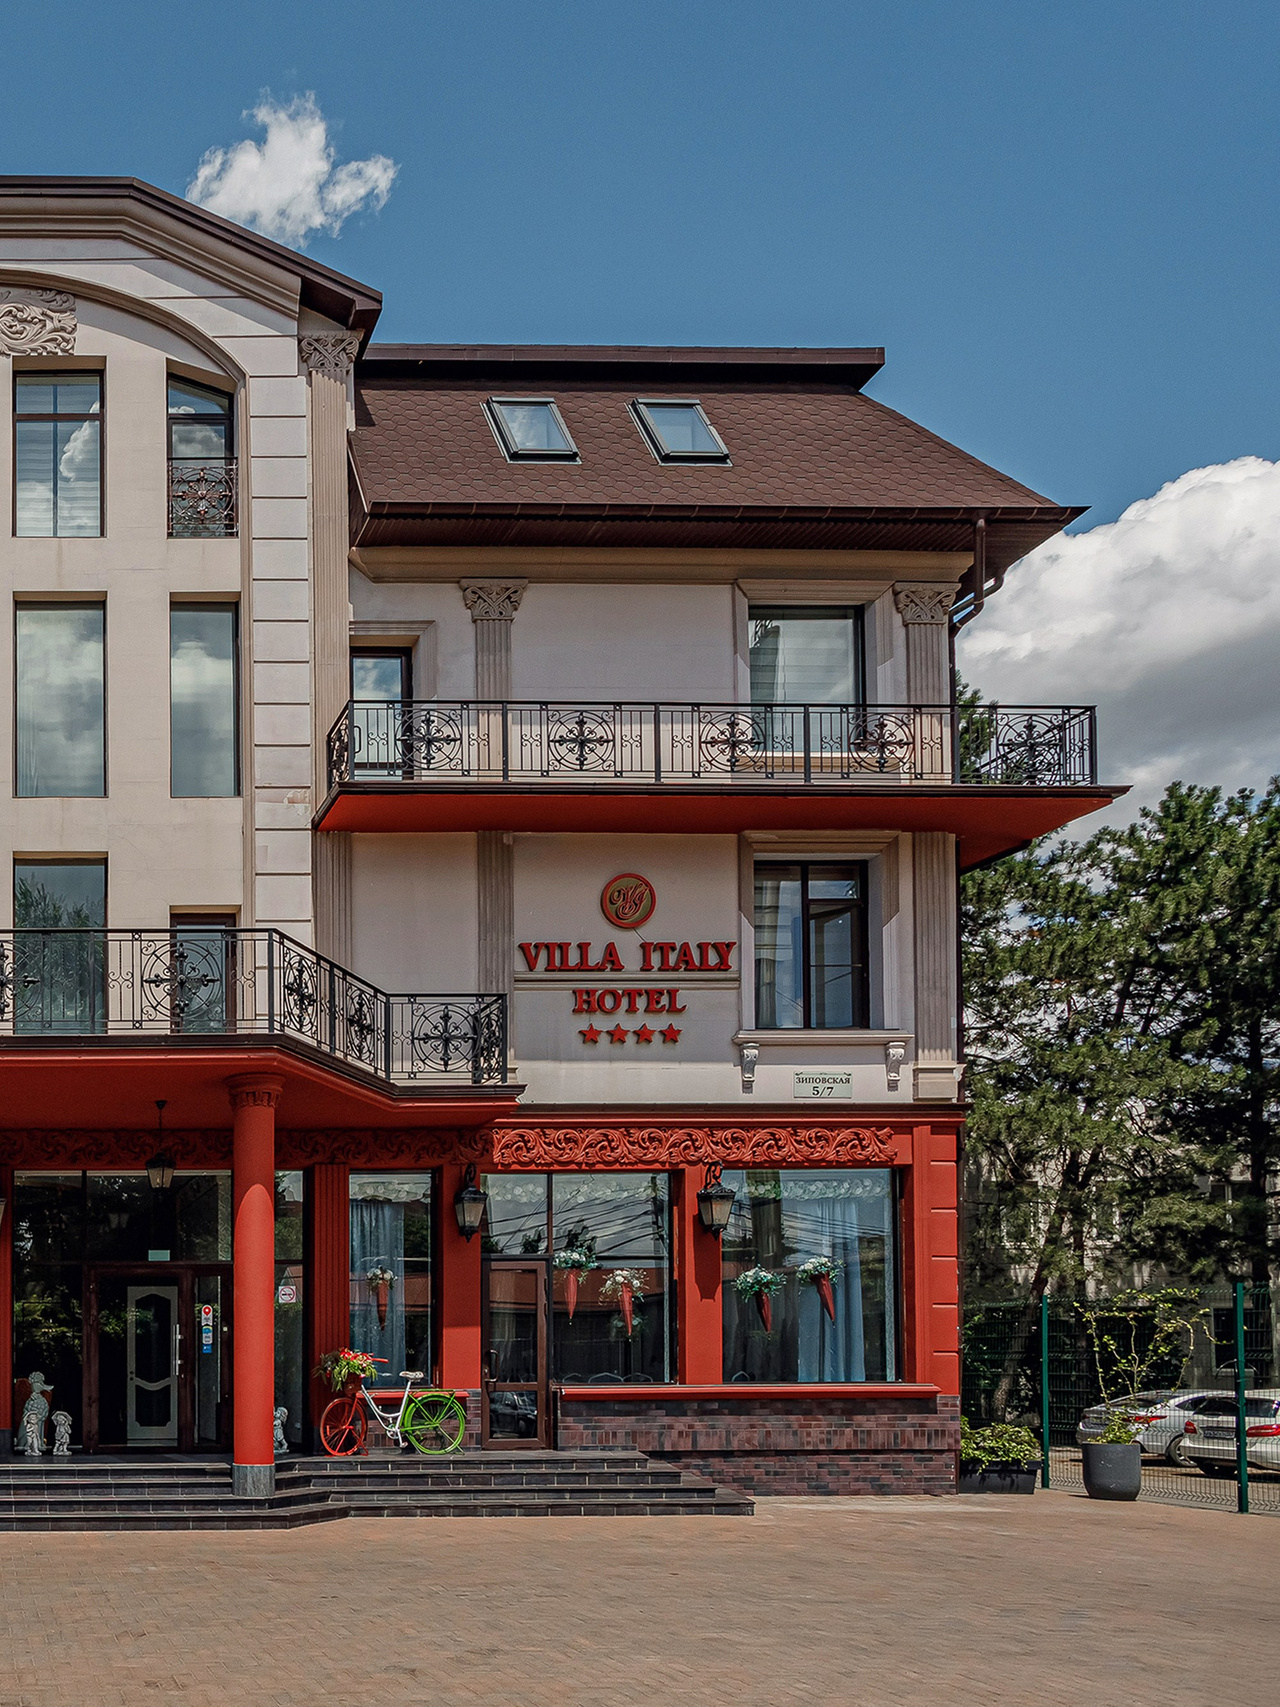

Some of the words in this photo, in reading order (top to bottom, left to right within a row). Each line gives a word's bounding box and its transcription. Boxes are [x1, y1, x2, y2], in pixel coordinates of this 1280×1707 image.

[518, 942, 625, 971] VILLA
[640, 942, 737, 971] ITALY
[572, 989, 687, 1013] HOTEL
[812, 1086, 834, 1096] 5/7
